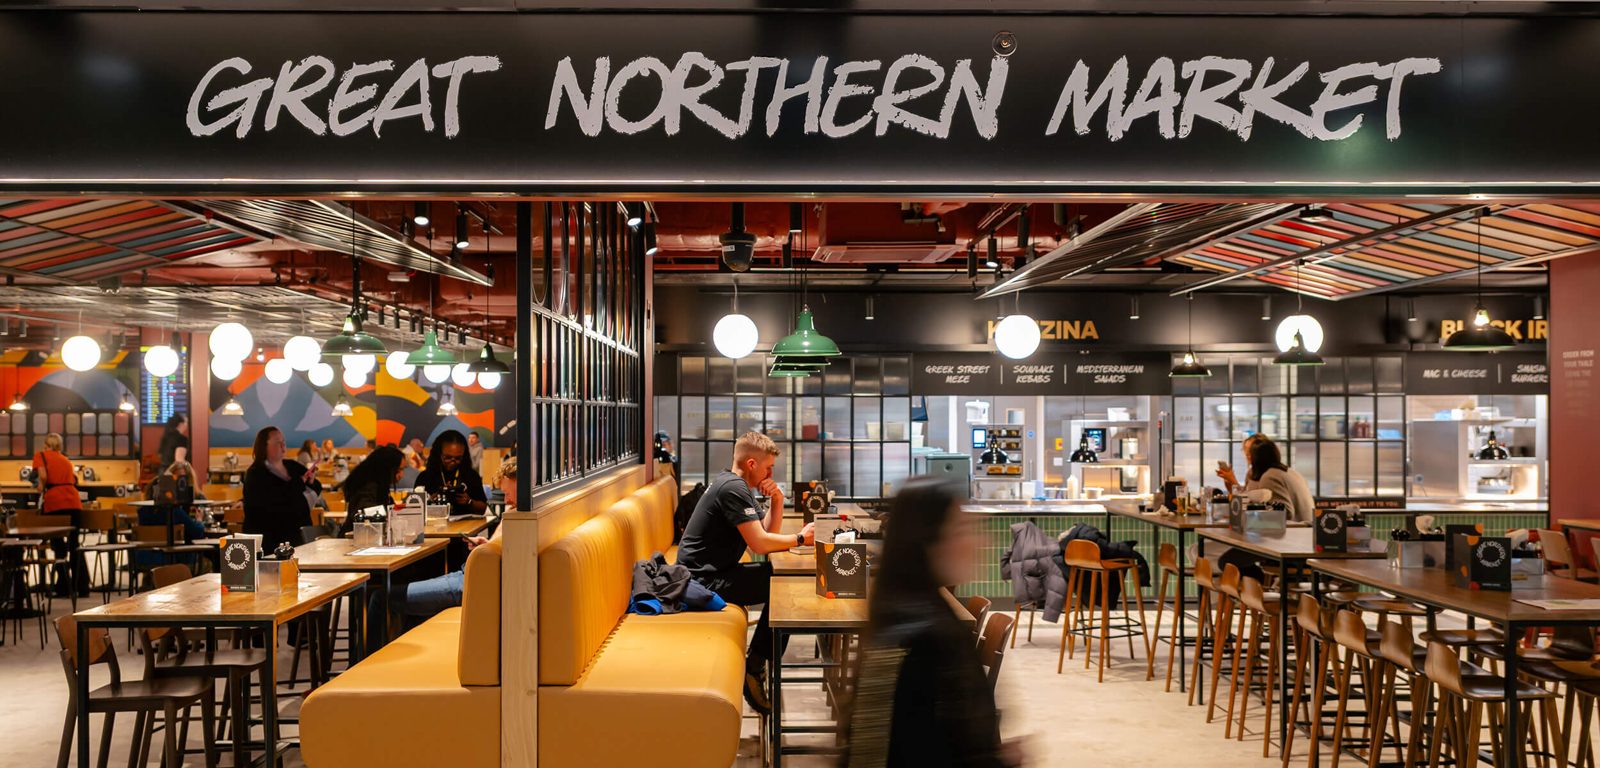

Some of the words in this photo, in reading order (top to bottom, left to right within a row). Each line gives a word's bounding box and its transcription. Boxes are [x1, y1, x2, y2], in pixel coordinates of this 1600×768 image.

[186, 56, 502, 138] GREAT
[545, 52, 1009, 139] NORTHERN
[1046, 56, 1442, 141] MARKET
[987, 320, 1099, 339] KZINA
[925, 365, 954, 374] GREEK
[956, 365, 990, 374] STREET
[1013, 365, 1054, 374] SOUVLAKI
[1076, 365, 1144, 374] MEDITERRANEAN
[1423, 369, 1441, 378] MAC
[1451, 369, 1487, 378] CHEESE
[945, 375, 970, 384] MEZE
[1016, 375, 1051, 384] KEBABS
[1094, 375, 1126, 384] SALADS
